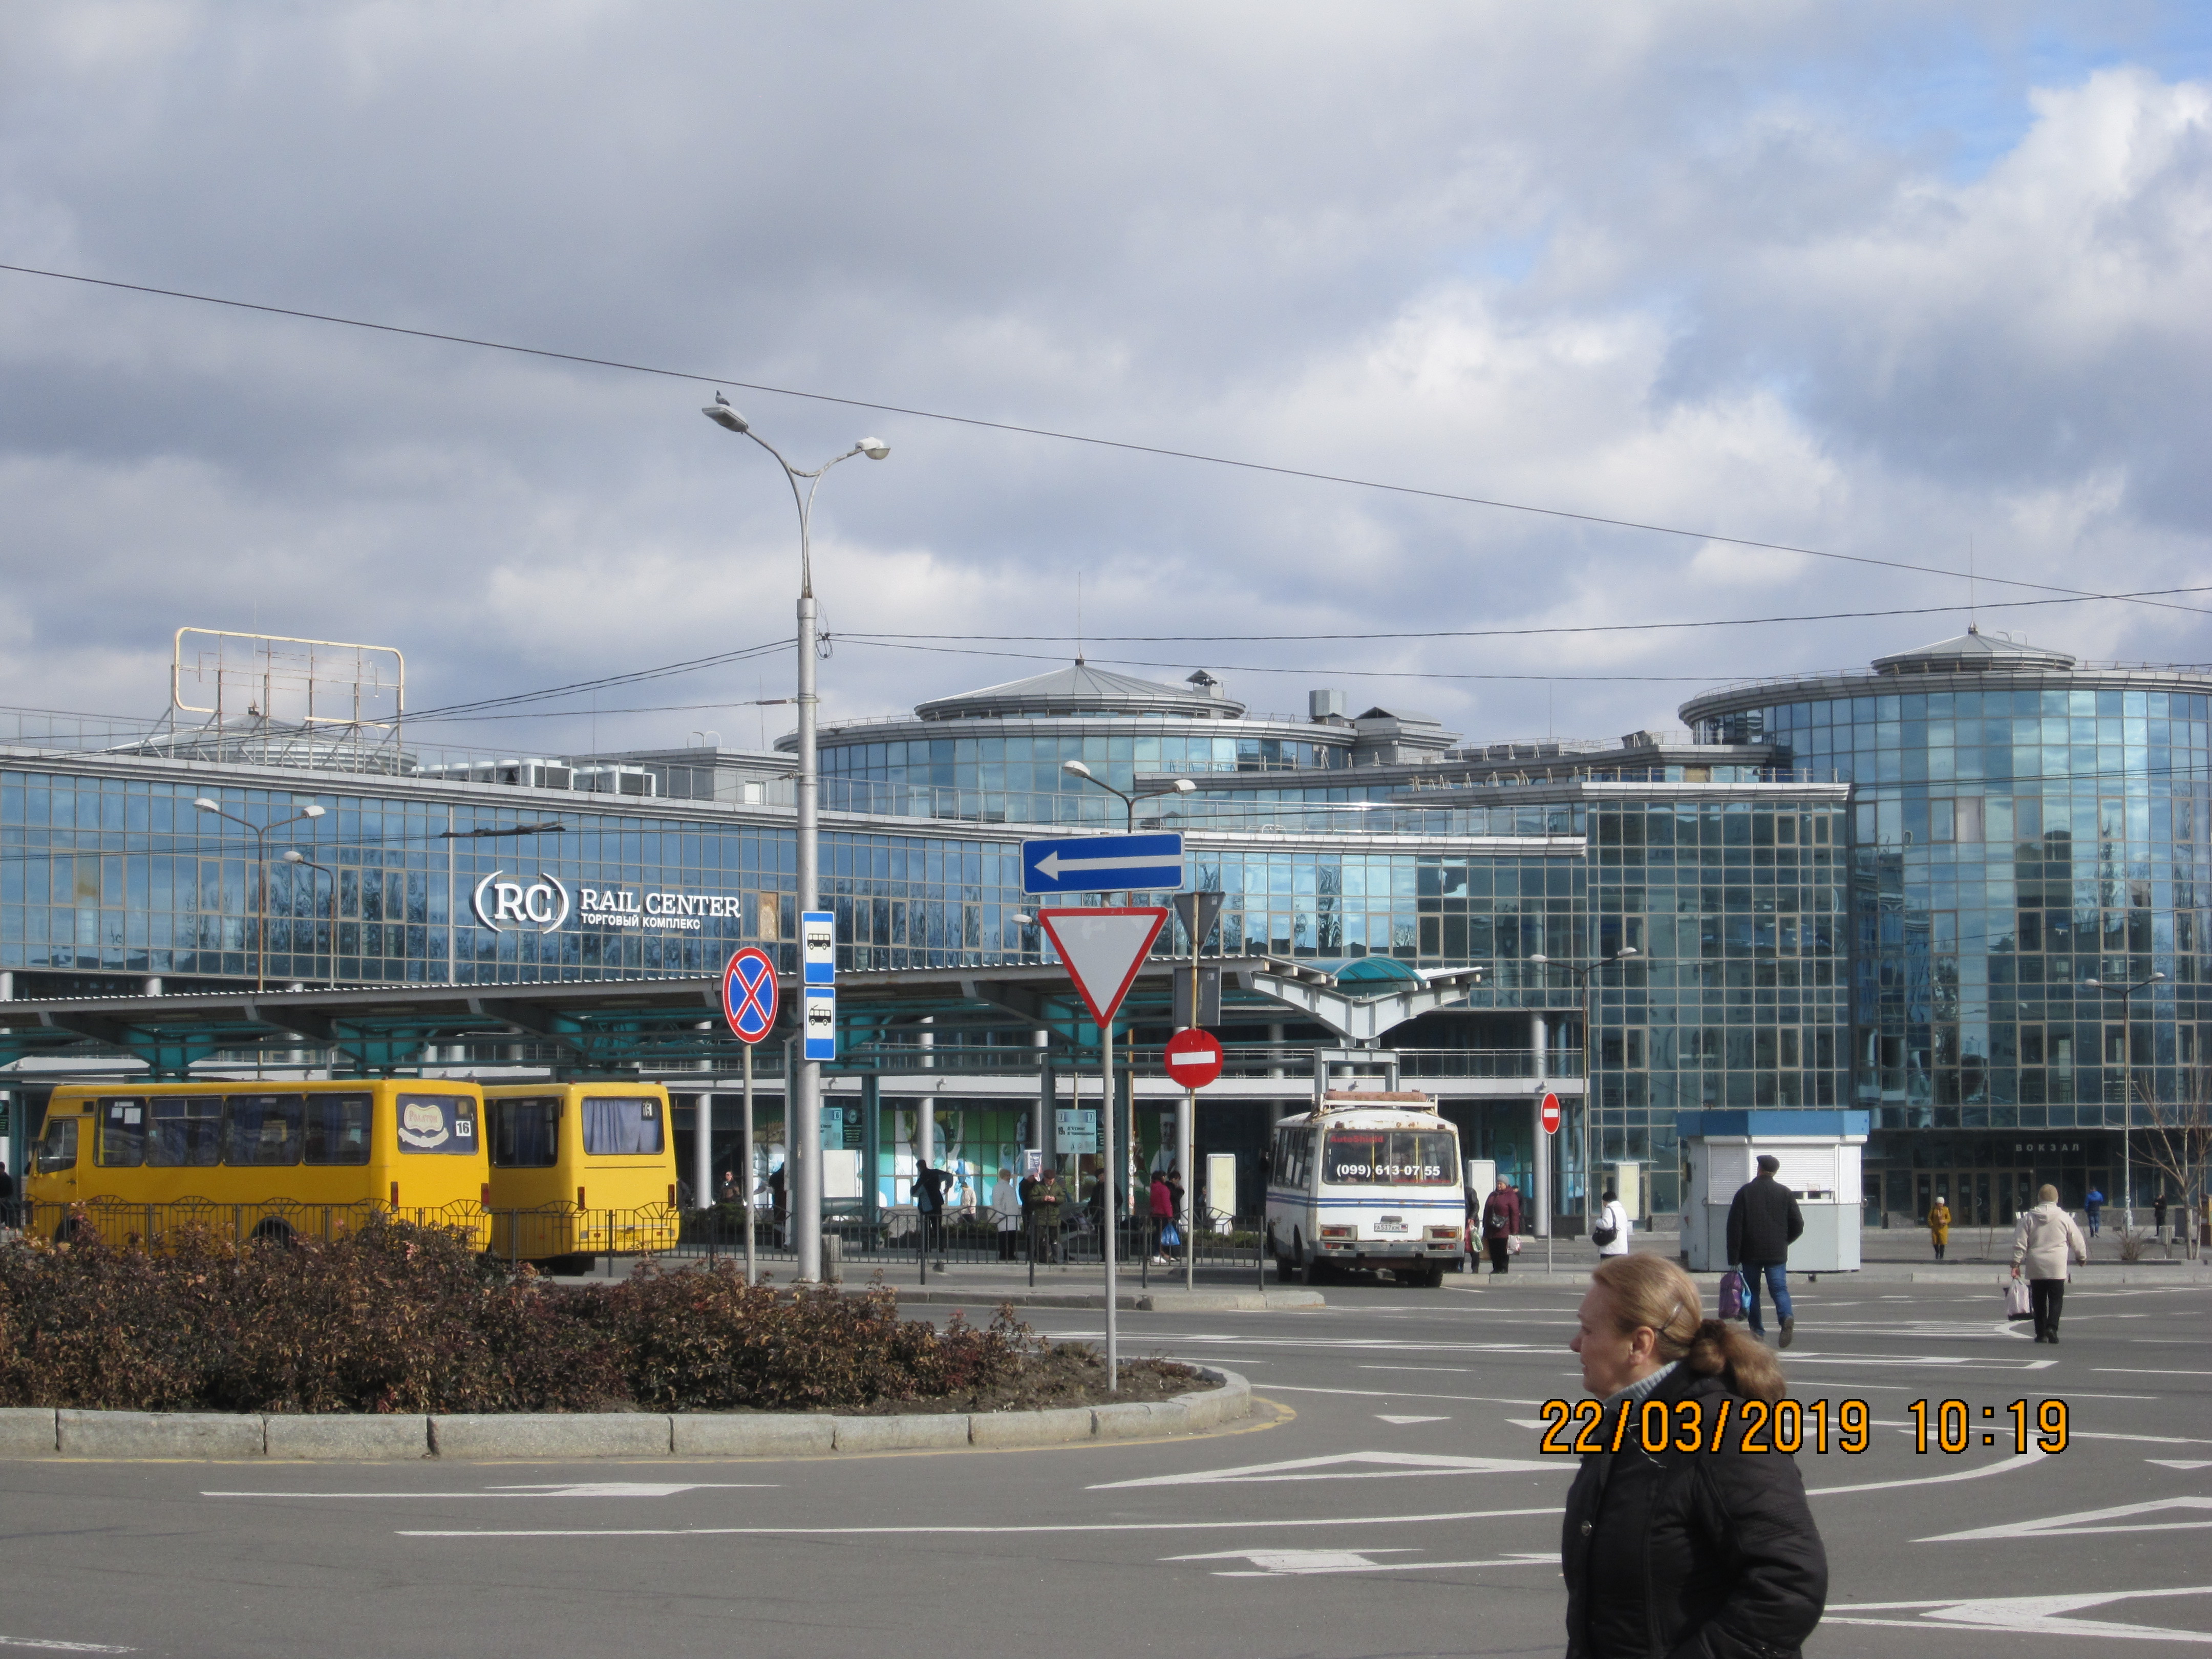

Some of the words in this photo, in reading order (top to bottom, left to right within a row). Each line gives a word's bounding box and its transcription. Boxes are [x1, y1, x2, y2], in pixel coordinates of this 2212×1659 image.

[581, 888, 641, 912] RAIL
[644, 893, 741, 918] CENTER
[581, 912, 639, 927] ТОРГОВЫЙ
[643, 917, 700, 930] КОМПЛЕКС
[457, 1122, 470, 1134] 16
[2015, 1143, 2079, 1152] ВОКЗАЛ
[1336, 1164, 1371, 1178] (099)
[1375, 1165, 1399, 1176] 613
[1404, 1165, 1420, 1176] 07
[1424, 1165, 1441, 1176] 55
